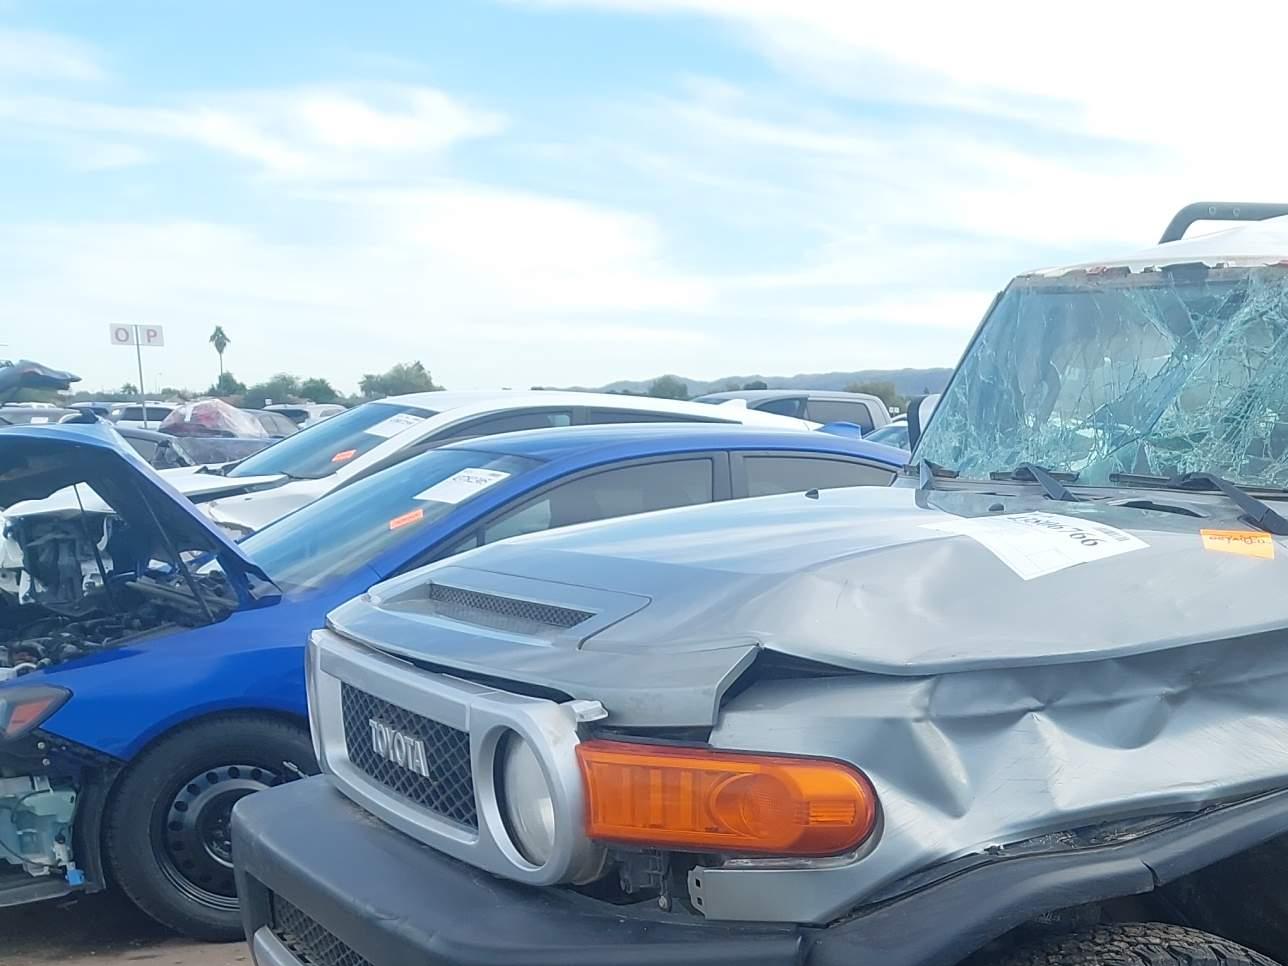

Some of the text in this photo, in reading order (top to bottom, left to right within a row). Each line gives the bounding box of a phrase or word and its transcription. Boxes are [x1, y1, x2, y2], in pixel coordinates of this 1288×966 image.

[116, 327, 158, 343] O P
[368, 719, 431, 778] TOYOTA
